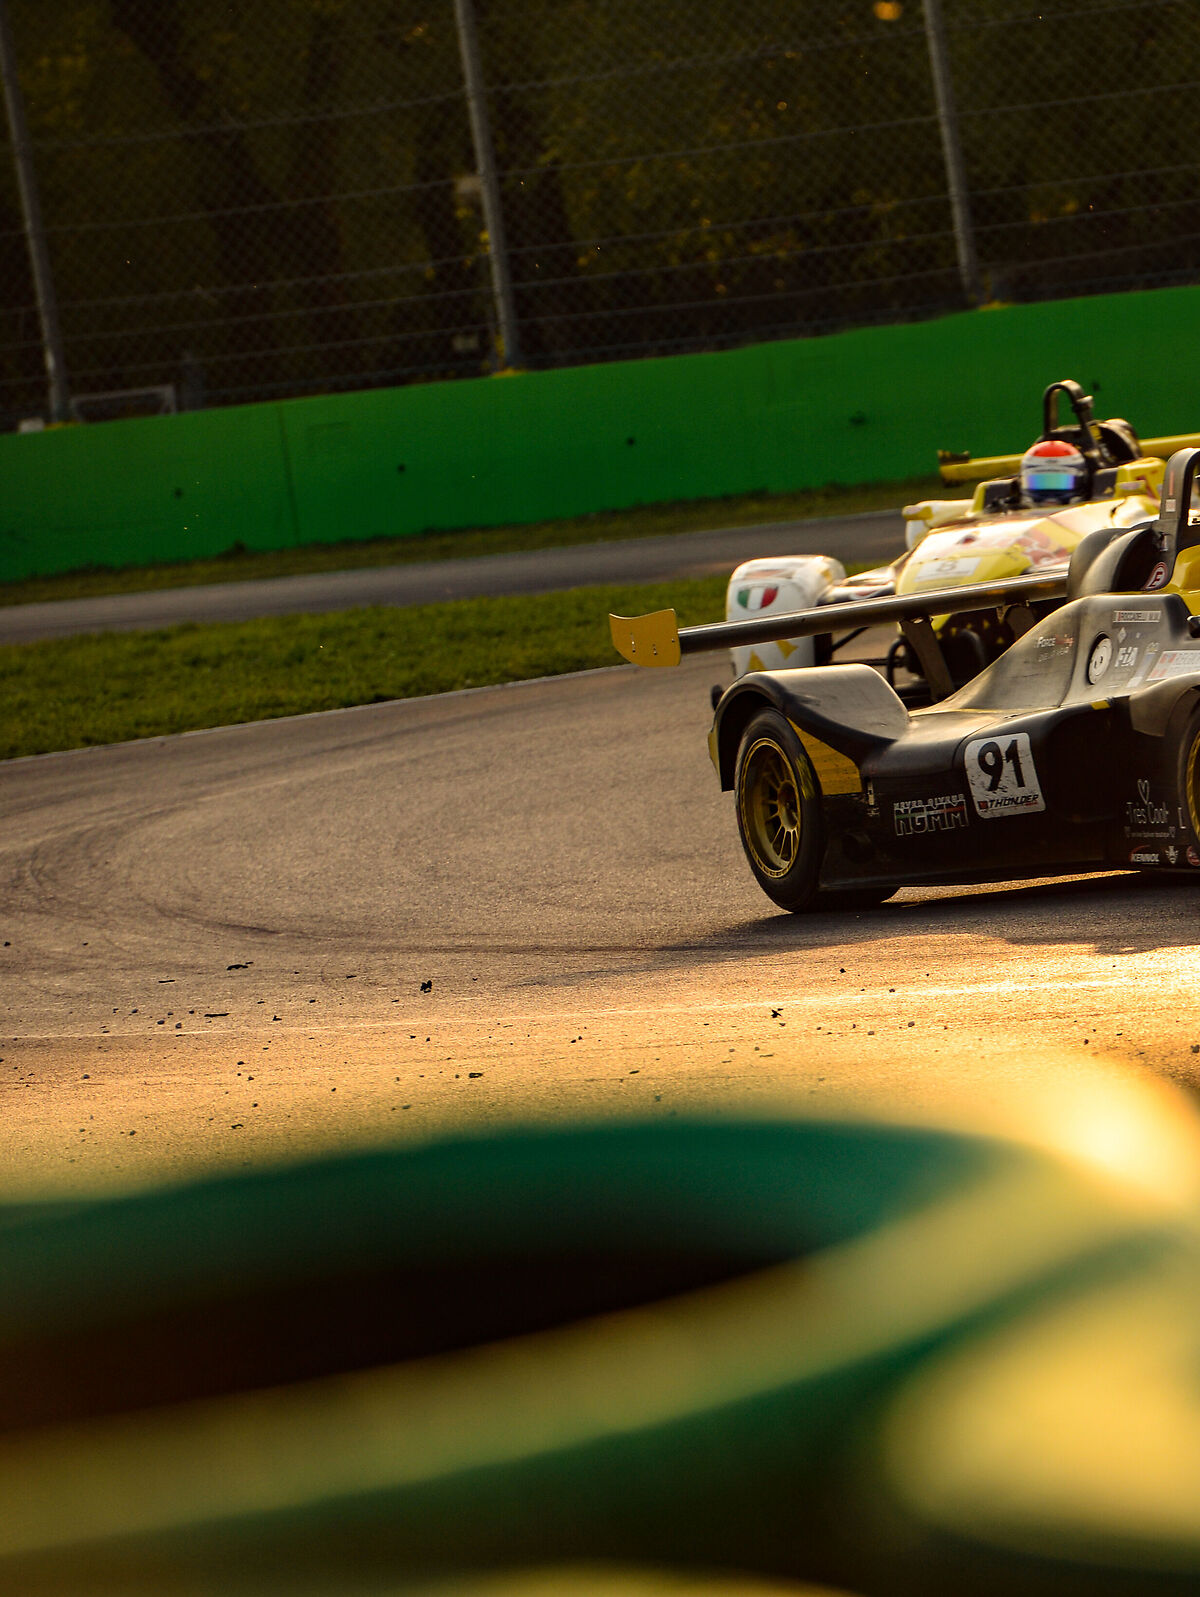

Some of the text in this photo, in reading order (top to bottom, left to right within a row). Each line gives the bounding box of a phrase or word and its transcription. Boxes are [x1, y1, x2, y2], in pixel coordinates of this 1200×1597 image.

[1148, 571, 1163, 587] E
[977, 739, 1026, 792] 91
[988, 794, 1039, 809] THUNDER
